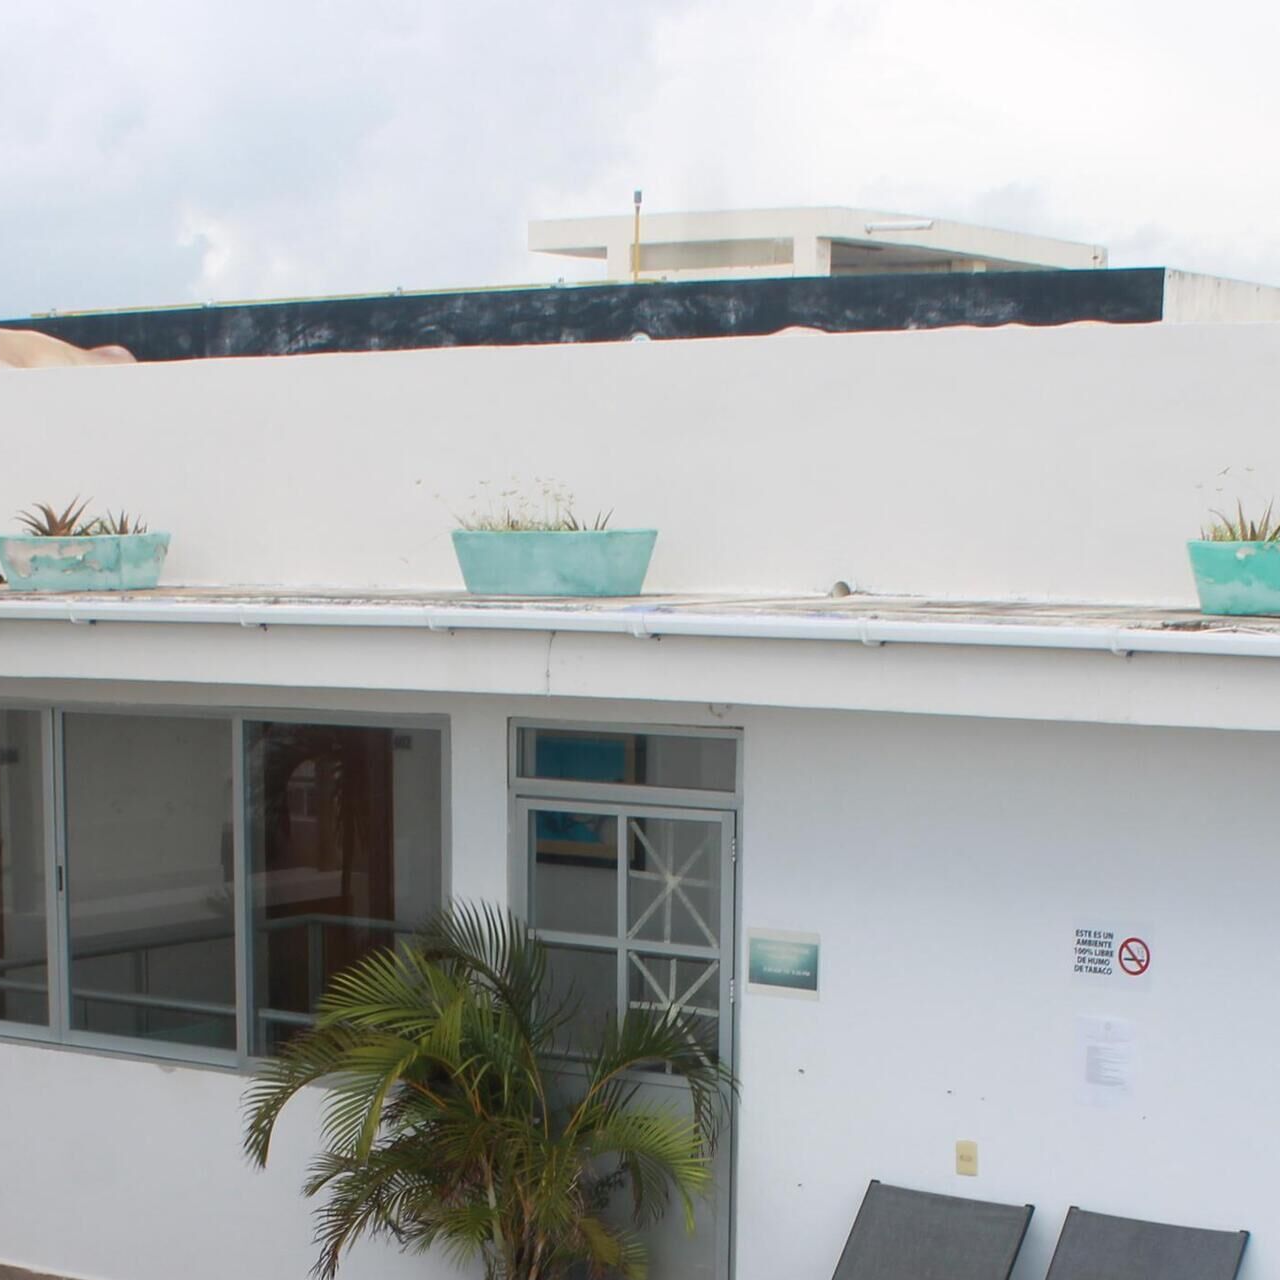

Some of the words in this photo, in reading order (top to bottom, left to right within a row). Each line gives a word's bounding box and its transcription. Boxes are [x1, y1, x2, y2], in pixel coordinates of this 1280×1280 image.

[1075, 929, 1092, 937] ESTE
[1093, 931, 1102, 939] ES
[1103, 932, 1114, 940] UN
[1076, 938, 1112, 948] AMBIENTE
[1074, 947, 1094, 956] 100%
[1094, 949, 1114, 958] LIBRE
[1077, 956, 1086, 964] DE
[1088, 957, 1110, 966] HUMO
[1074, 965, 1084, 973] DE
[1085, 966, 1113, 975] TABACO
